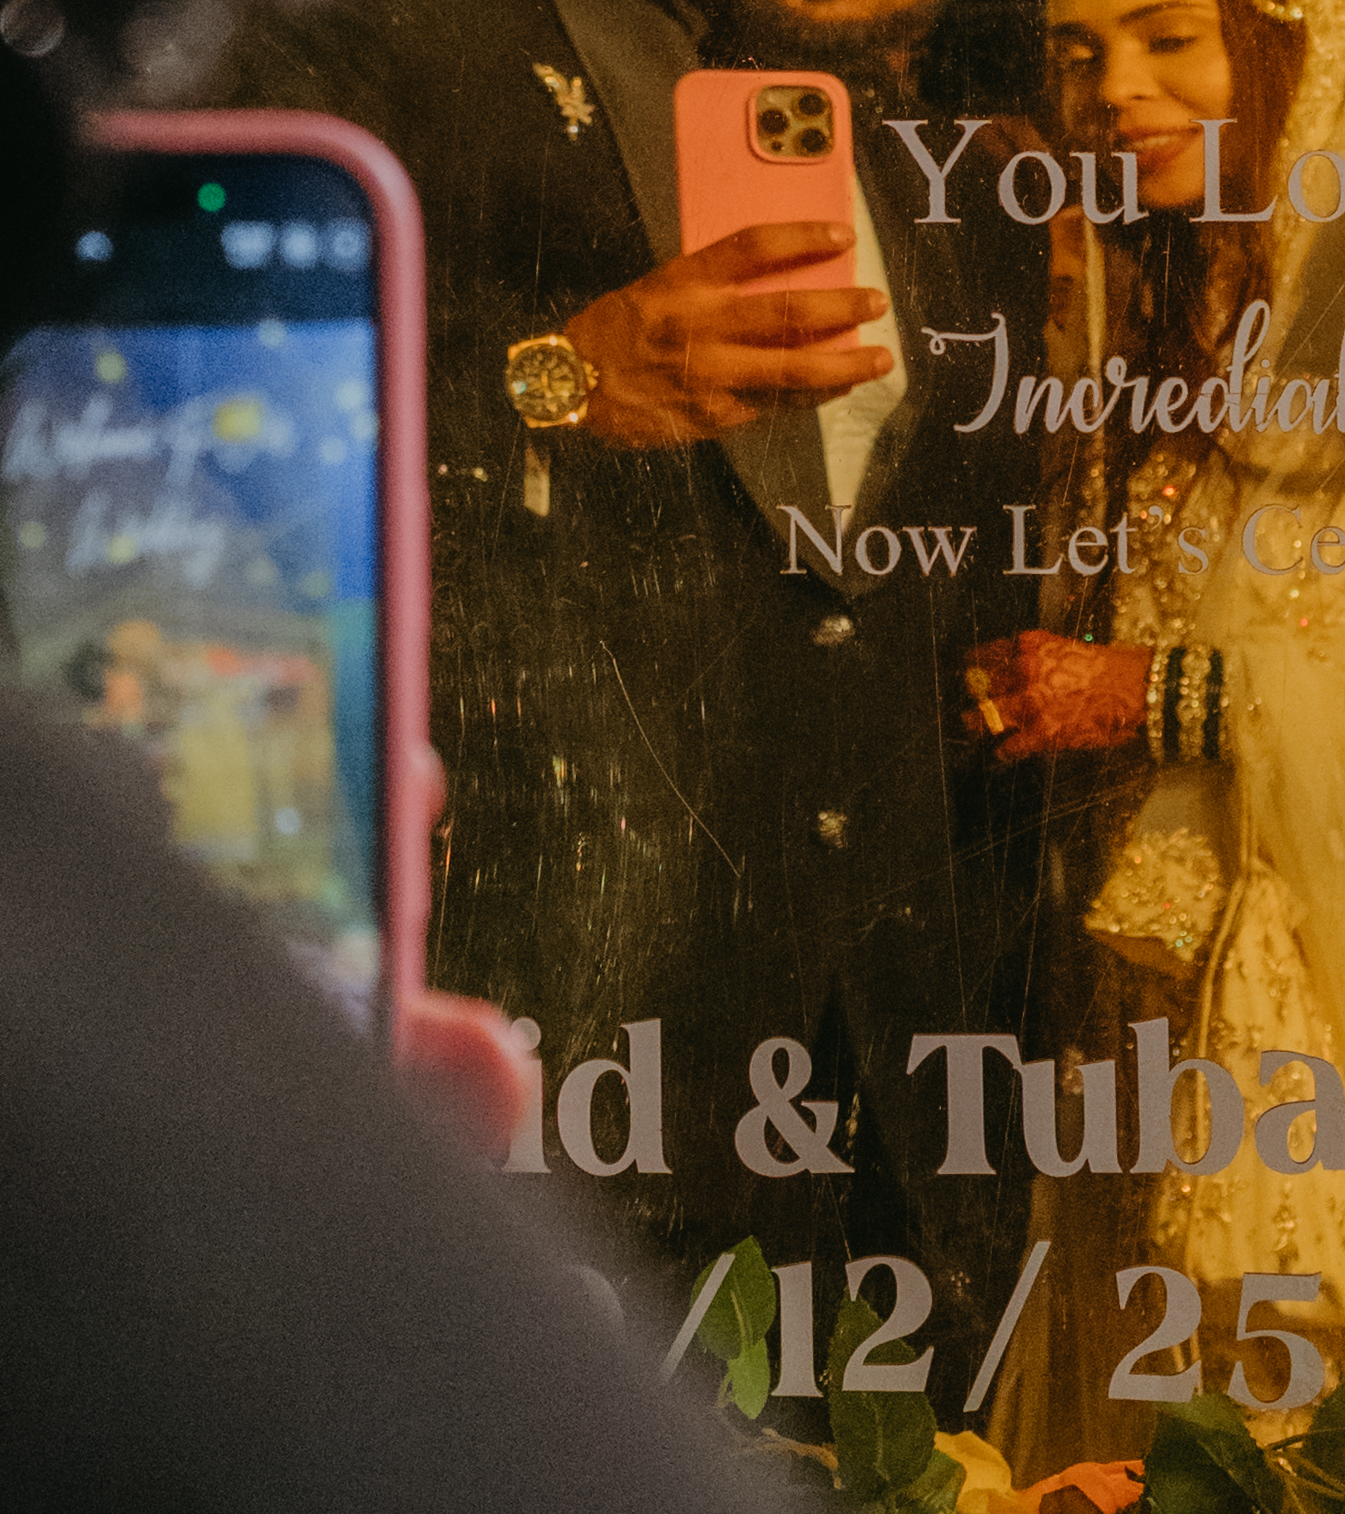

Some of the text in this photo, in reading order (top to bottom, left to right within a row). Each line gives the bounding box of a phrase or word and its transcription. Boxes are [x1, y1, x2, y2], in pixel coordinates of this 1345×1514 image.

[882, 119, 1146, 227] You
[778, 505, 976, 576] Now
[1003, 503, 1209, 576] Let’s
[504, 1017, 672, 1176] id
[734, 1036, 855, 1177] &
